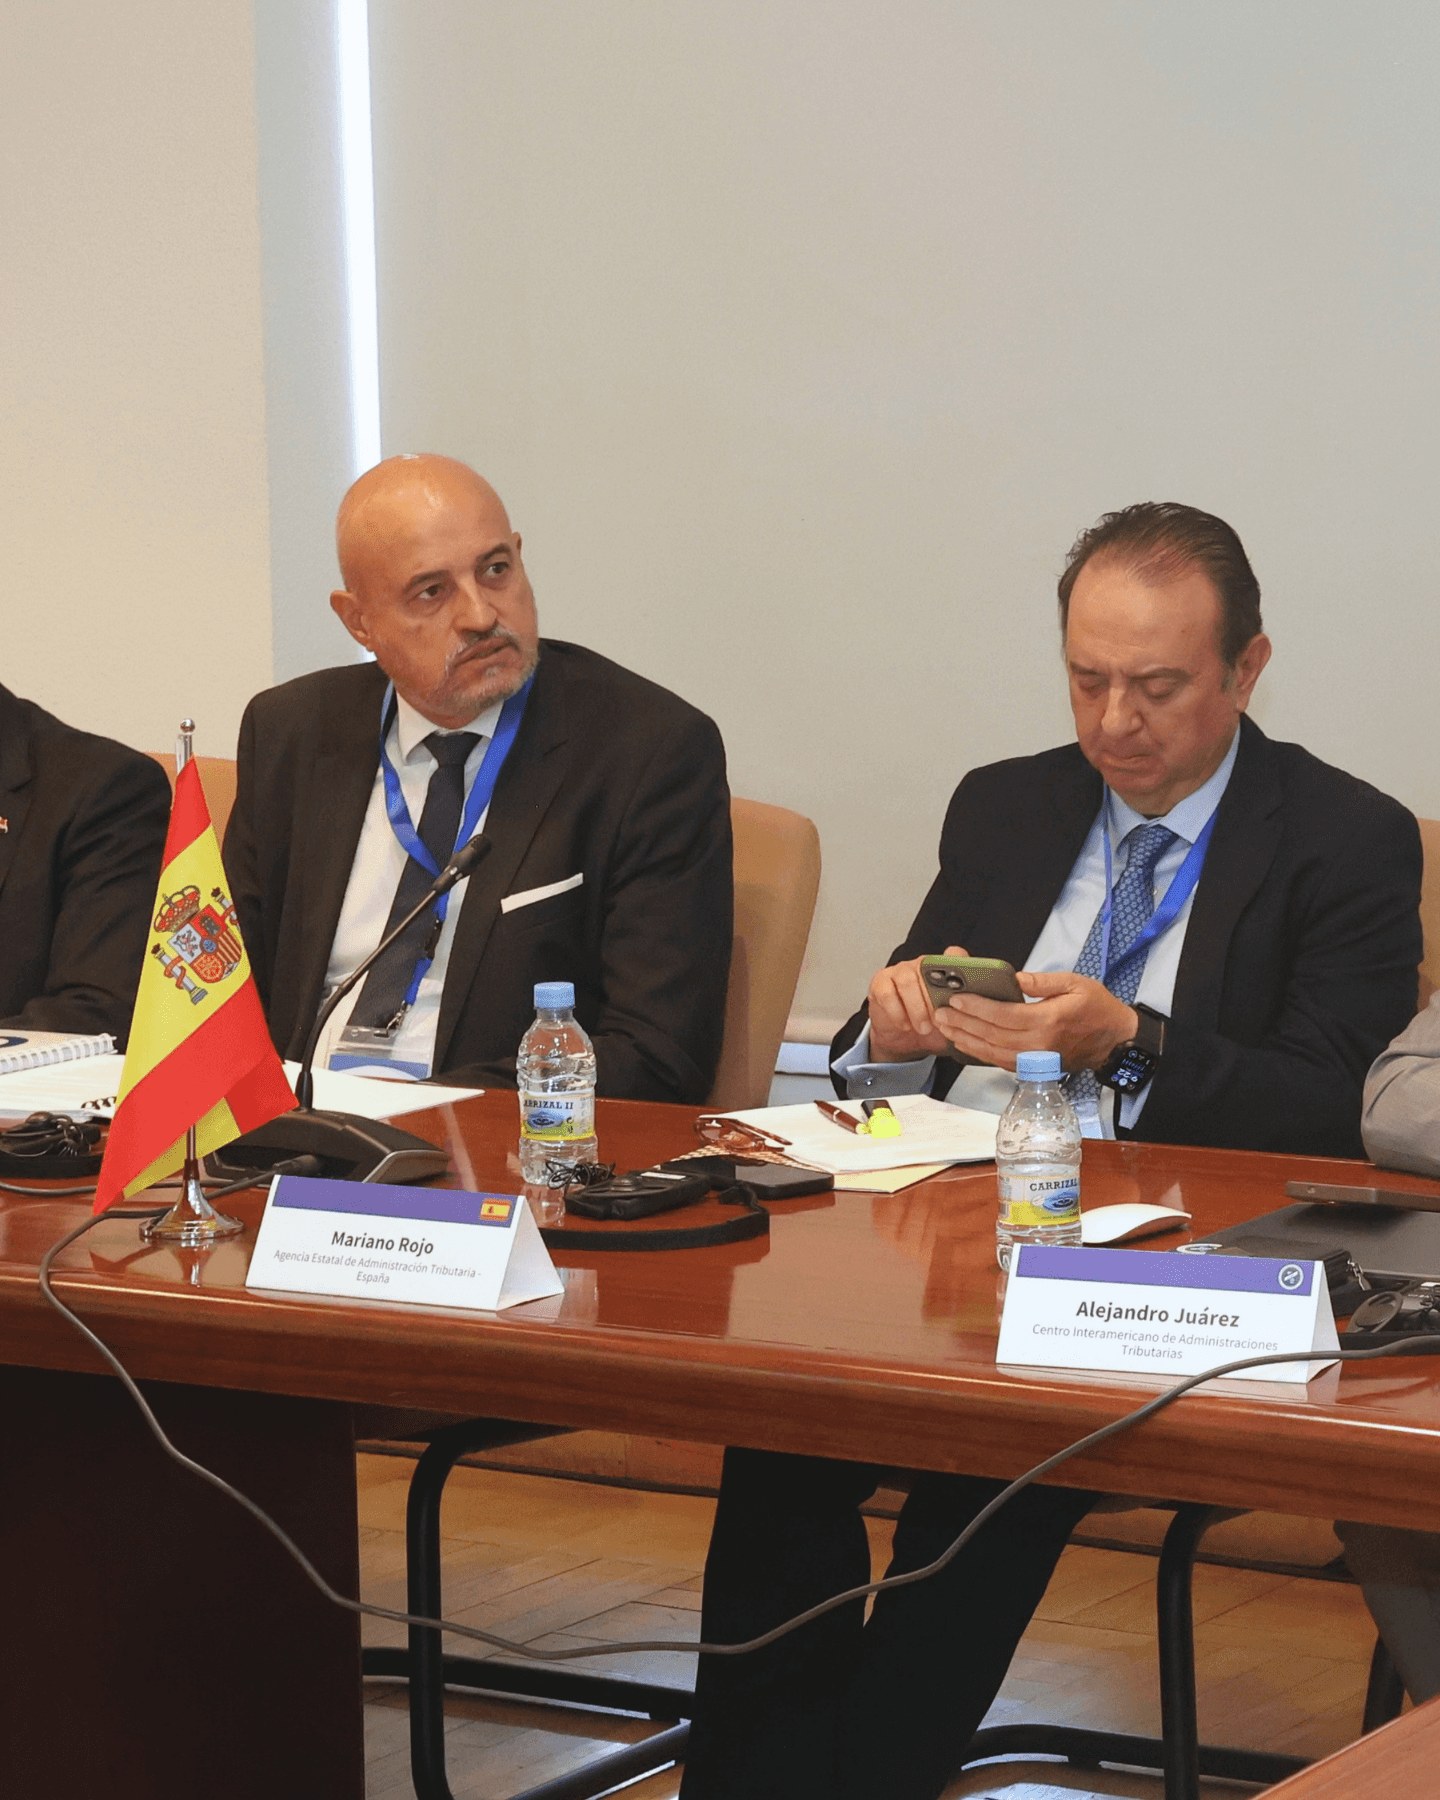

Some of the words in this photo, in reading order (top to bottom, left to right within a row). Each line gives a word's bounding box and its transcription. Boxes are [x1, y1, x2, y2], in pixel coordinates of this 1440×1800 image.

[331, 1231, 395, 1251] Mariano
[398, 1237, 434, 1257] Rojo
[273, 1250, 310, 1262] Agencia
[311, 1253, 343, 1265] Estatal
[344, 1256, 357, 1267] de
[358, 1257, 428, 1273] Administración
[431, 1264, 476, 1278] Tributaria
[356, 1271, 390, 1284] España
[1076, 1301, 1169, 1322] Alejandro
[1174, 1306, 1240, 1327] Juárez
[1032, 1324, 1070, 1336] Centro
[1073, 1327, 1159, 1342] Interamericano
[1162, 1332, 1177, 1343] de
[1178, 1334, 1278, 1351] Administraciones
[1122, 1345, 1183, 1359] Tributarias
